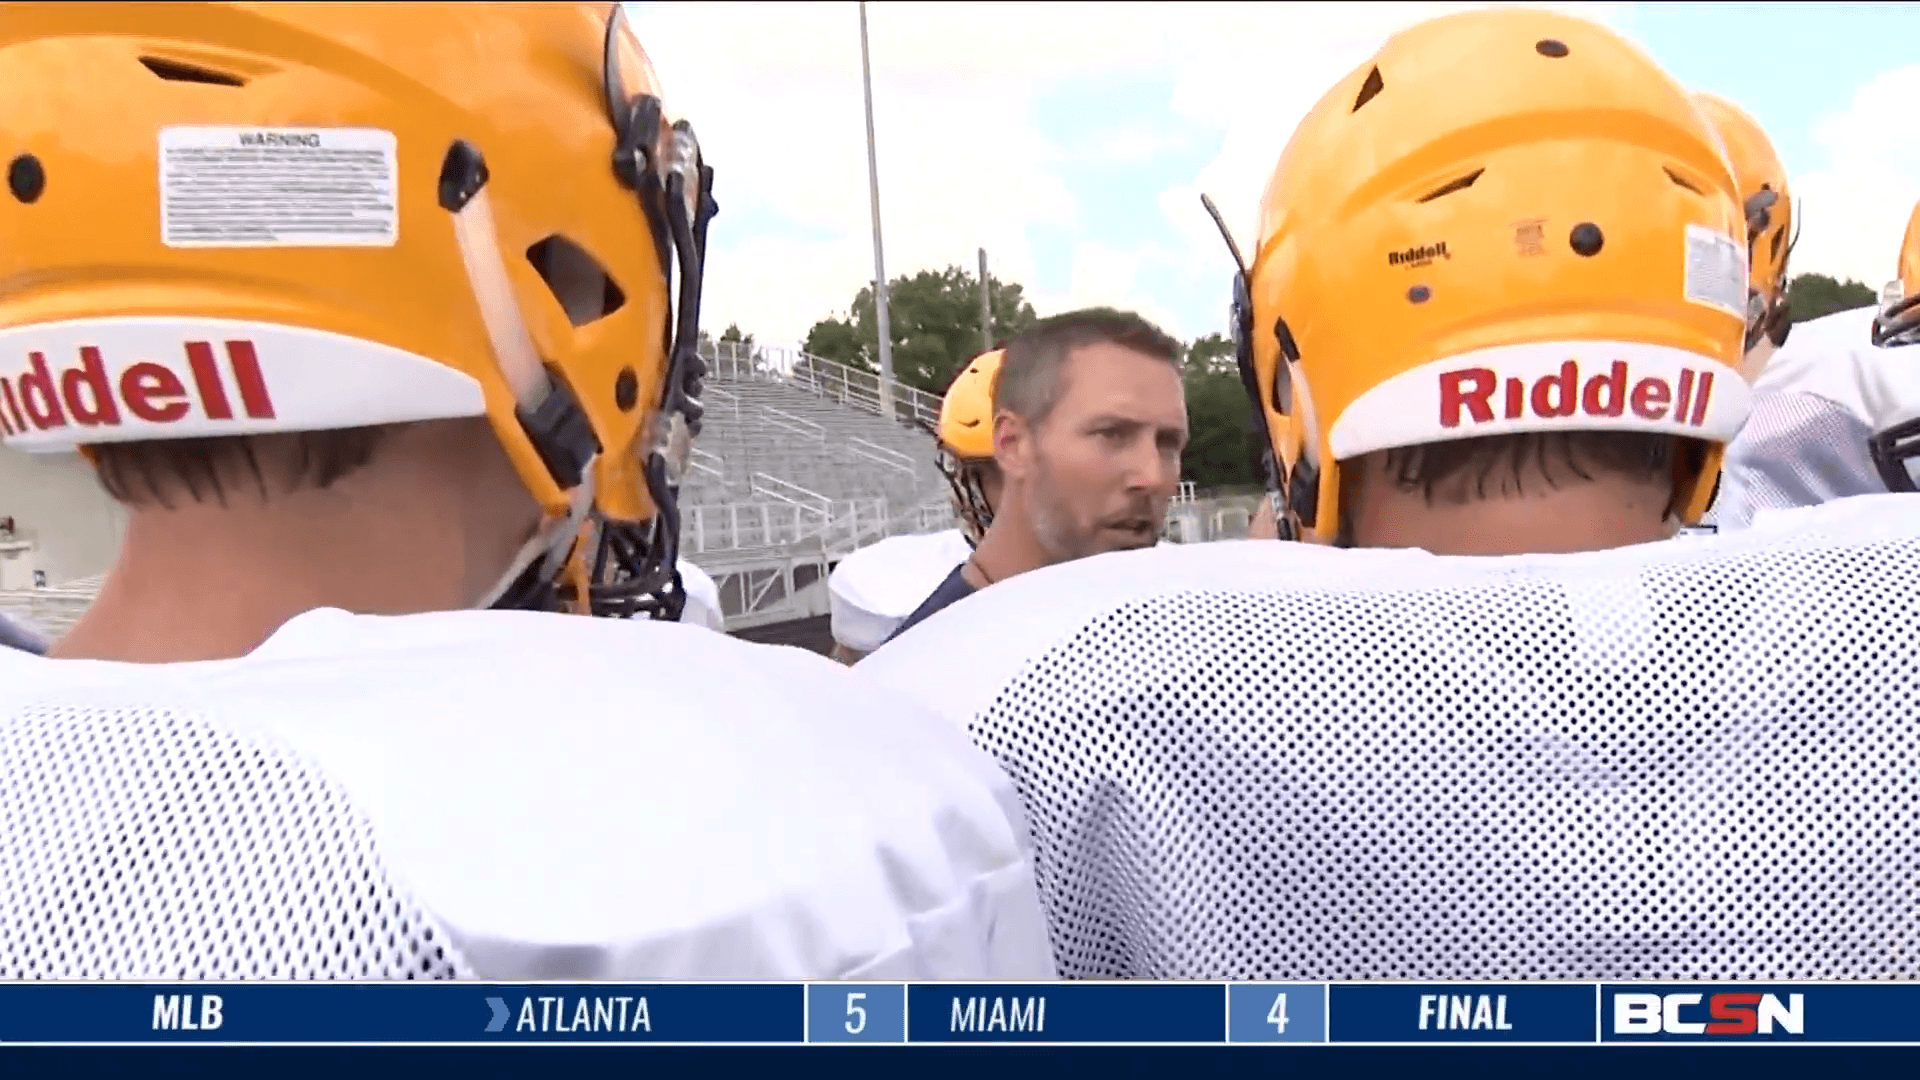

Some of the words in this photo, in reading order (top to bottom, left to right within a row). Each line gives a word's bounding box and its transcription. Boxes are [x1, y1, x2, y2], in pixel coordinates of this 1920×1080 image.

[239, 133, 321, 147] WARNING
[0, 341, 275, 436] iddell
[1439, 360, 1714, 428] Riddell
